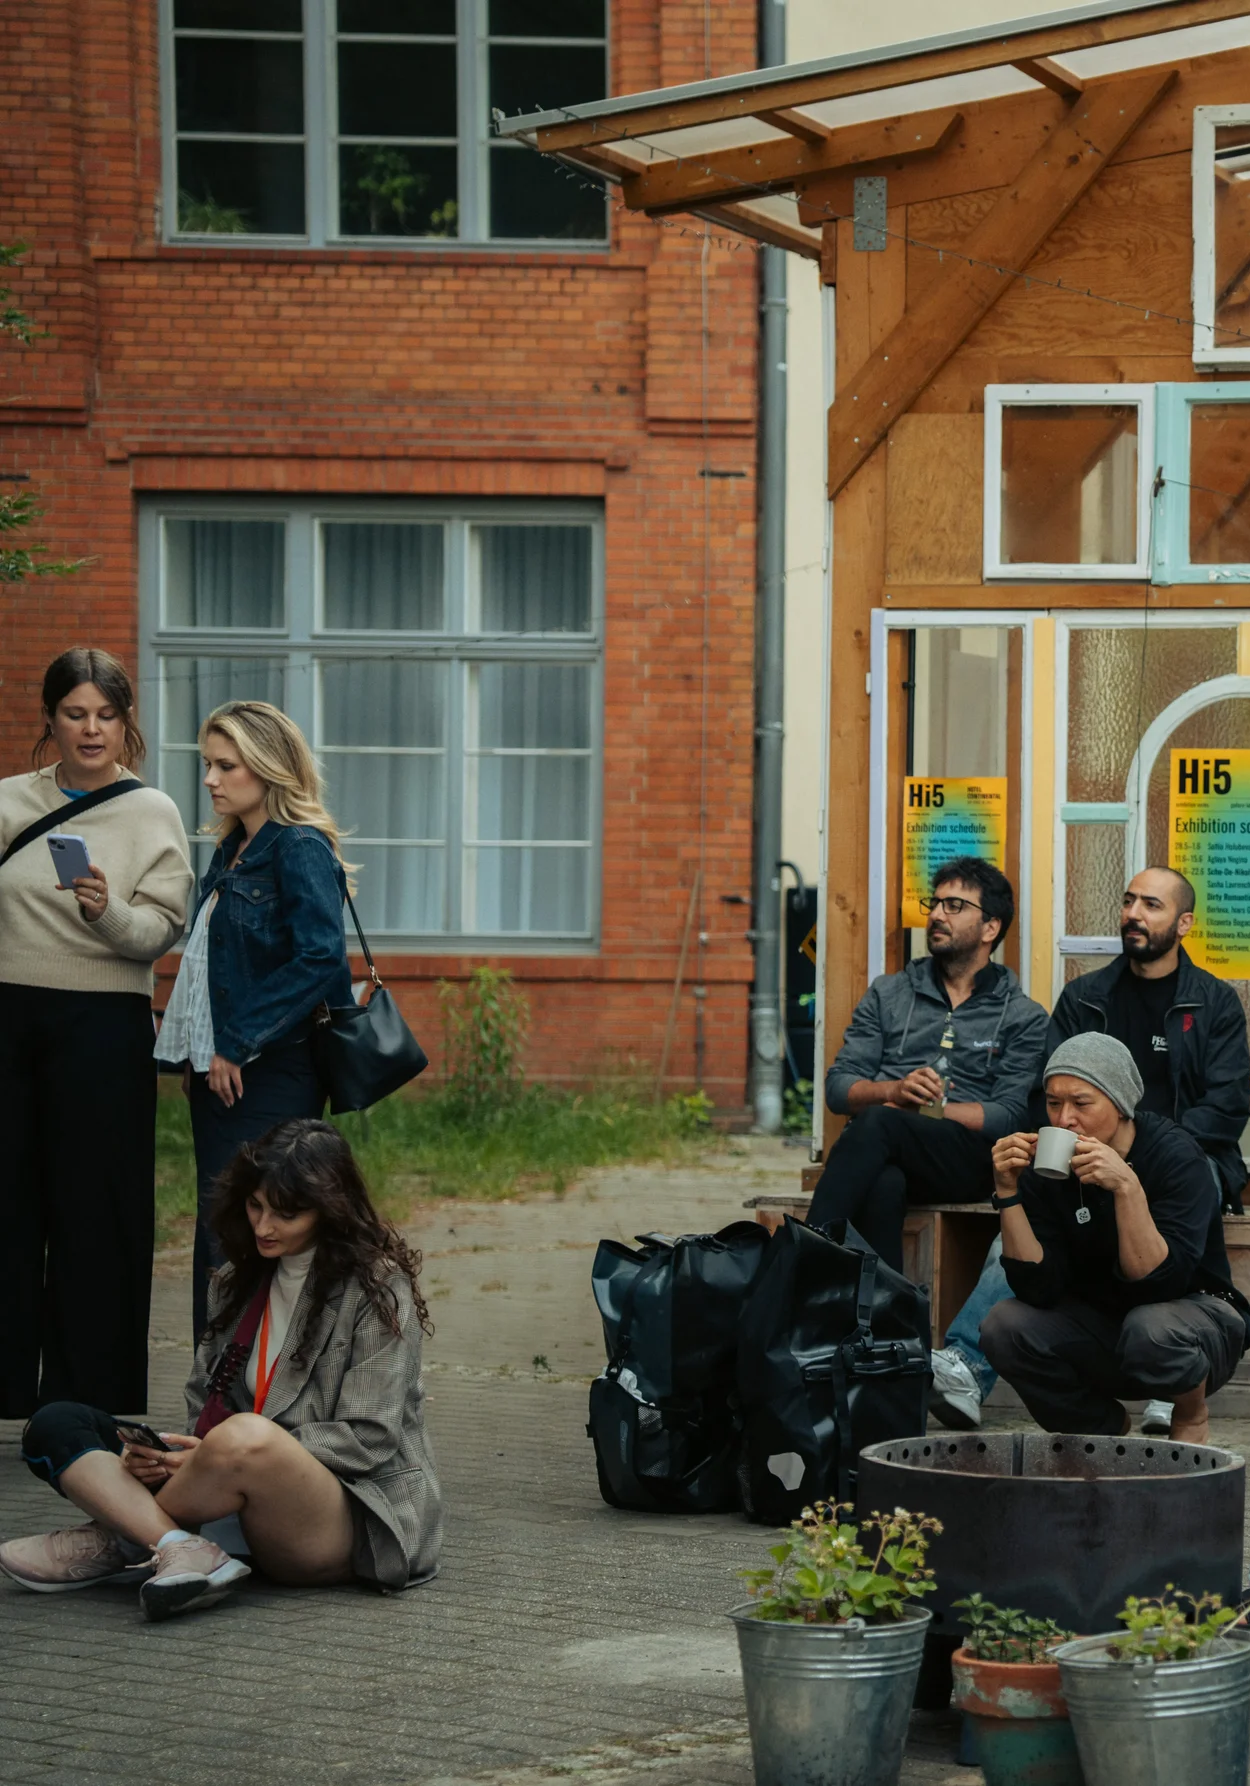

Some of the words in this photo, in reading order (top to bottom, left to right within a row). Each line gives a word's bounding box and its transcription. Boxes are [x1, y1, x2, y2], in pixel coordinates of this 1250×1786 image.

[1178, 759, 1232, 795] Hi5
[909, 784, 945, 807] Hi5
[906, 822, 947, 833] Exhibition
[949, 823, 987, 833] schedule
[1175, 817, 1236, 833] Exhibition
